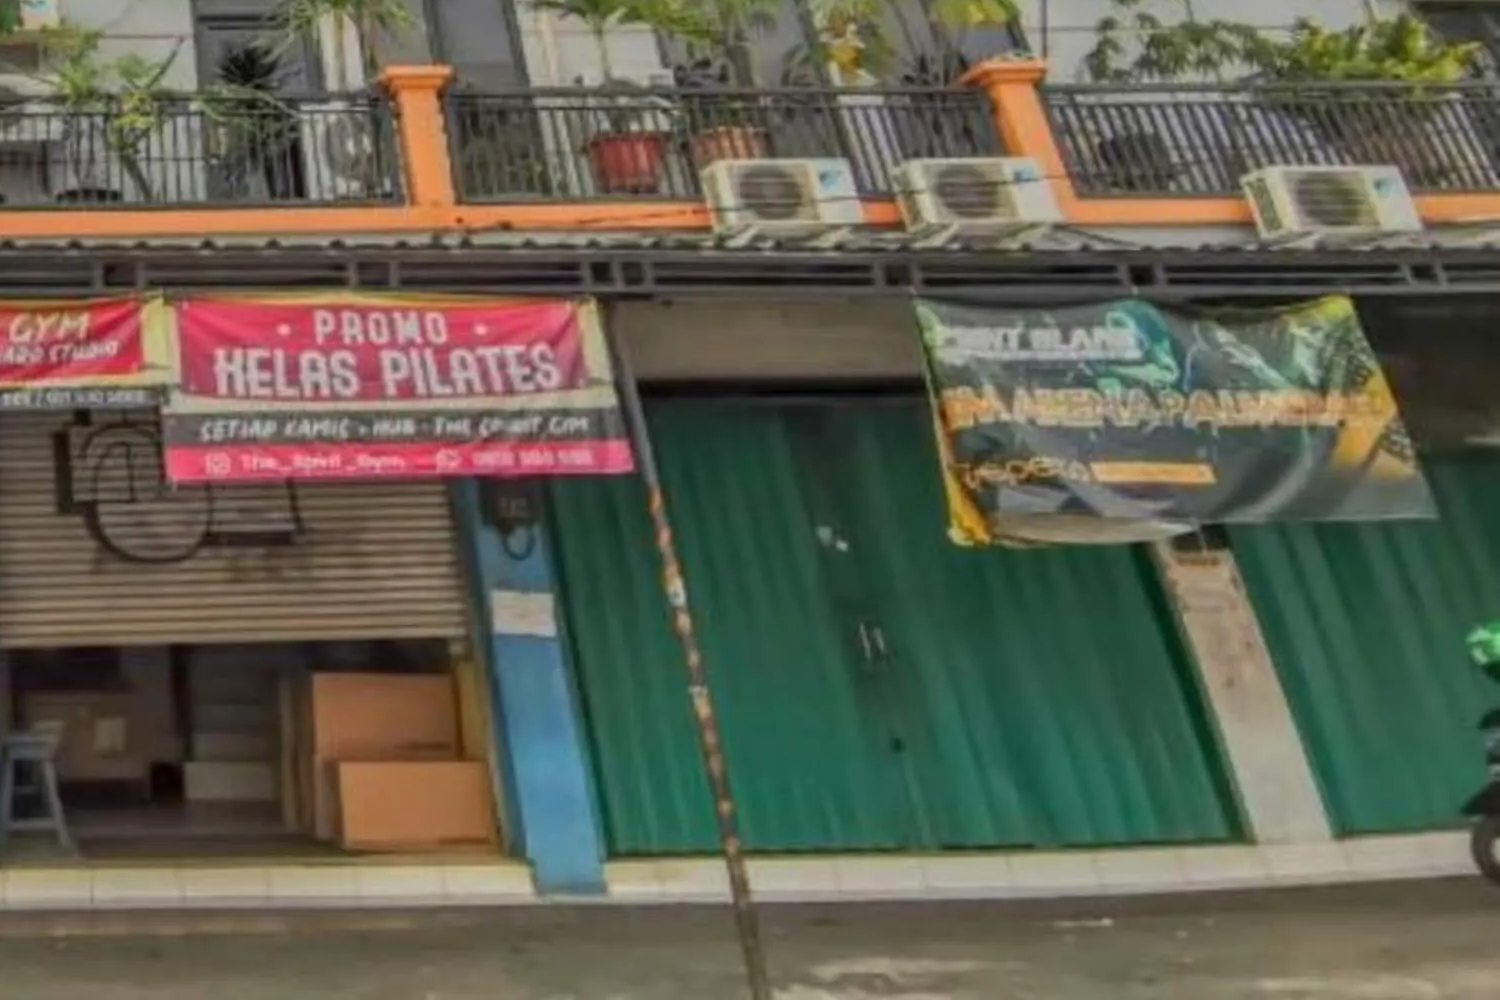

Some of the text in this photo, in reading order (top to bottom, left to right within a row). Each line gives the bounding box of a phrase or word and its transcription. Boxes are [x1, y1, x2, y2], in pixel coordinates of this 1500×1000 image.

[7, 310, 90, 343] GYM
[313, 310, 447, 345] PROMO
[214, 344, 561, 398] KELAS PILATES
[200, 417, 278, 443] SETIAP
[284, 416, 350, 440] KAMIS
